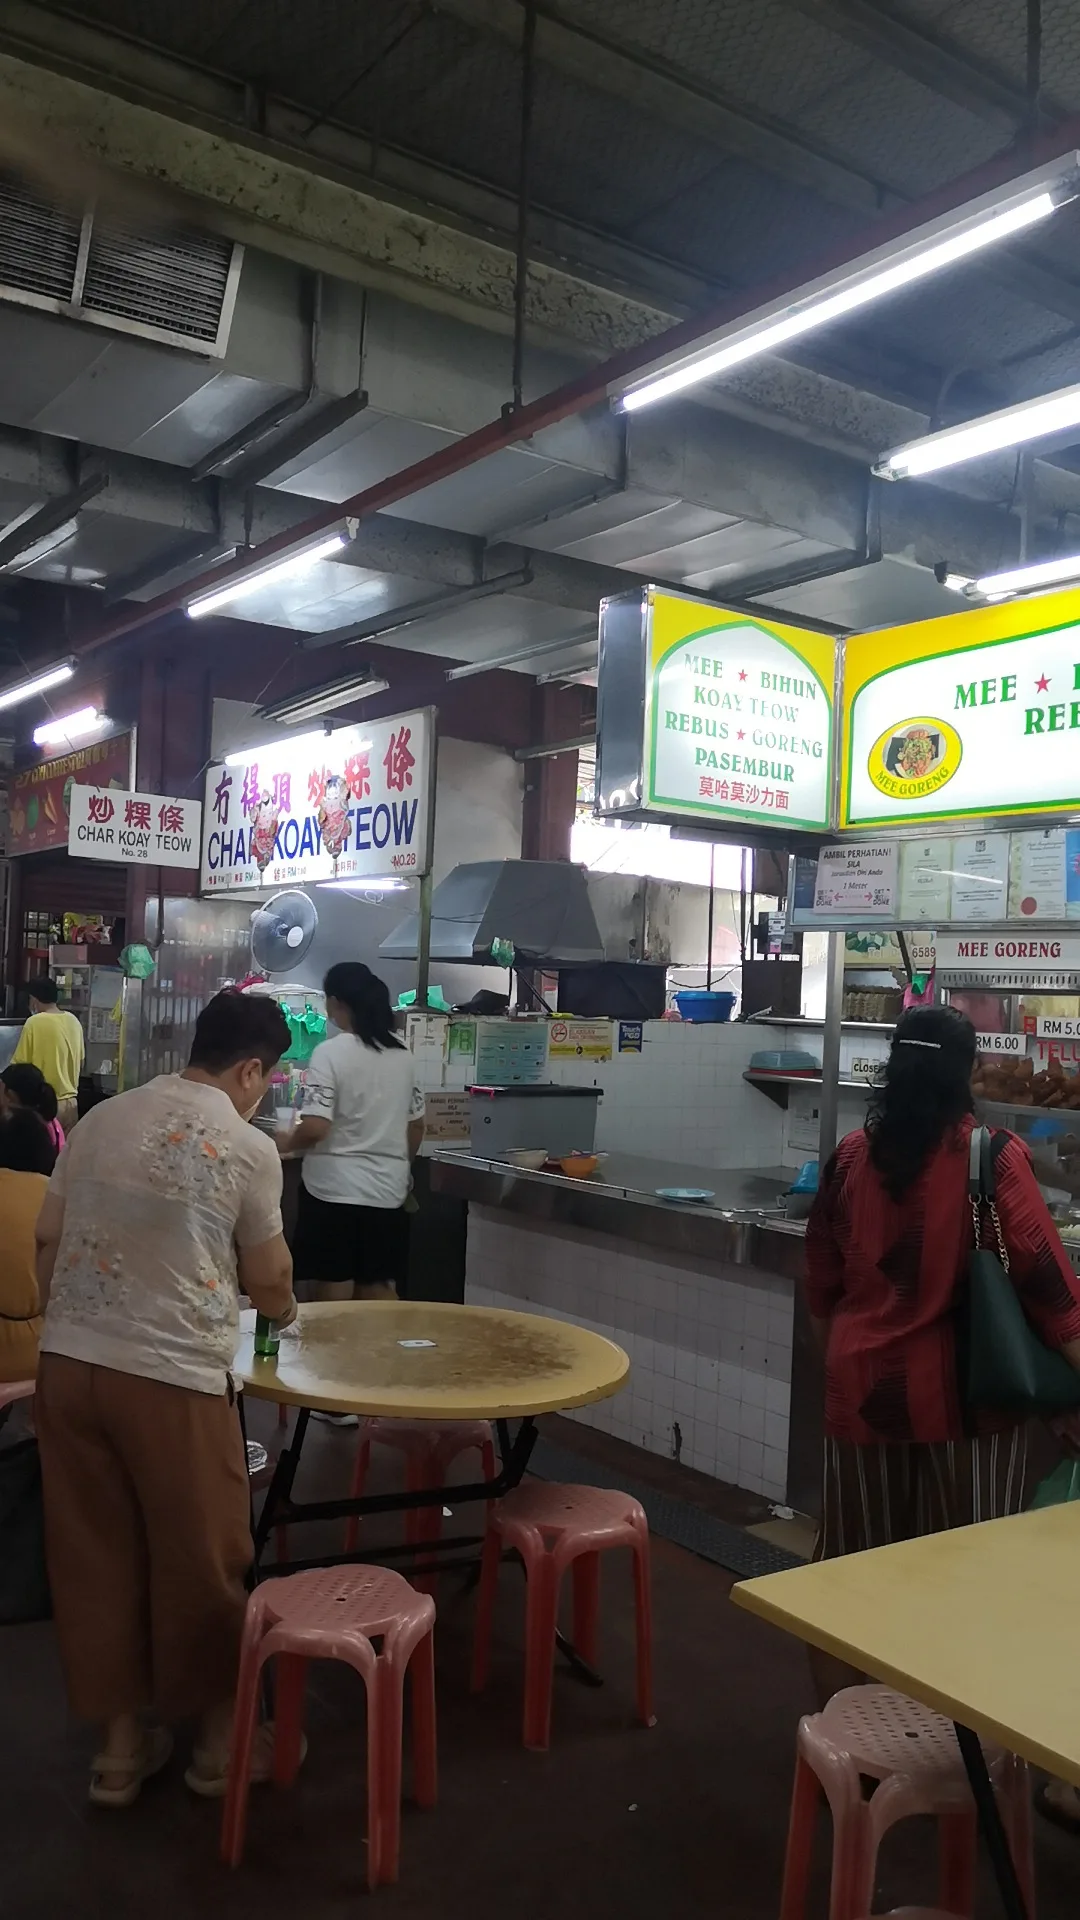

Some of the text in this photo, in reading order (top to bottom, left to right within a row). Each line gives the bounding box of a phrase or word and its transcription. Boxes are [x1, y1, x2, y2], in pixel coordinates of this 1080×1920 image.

[684, 653, 817, 700] MEE BIHUN
[693, 685, 799, 723] KOAY TEOW
[954, 675, 1017, 709] MEE
[664, 710, 823, 758] REBUS GORENG
[694, 747, 795, 782] PASEMBUR
[699, 776, 790, 810] 莫哈莫沙力面
[875, 766, 950, 795] MEE GORENG
[87, 794, 184, 833] 炒粿條
[78, 825, 114, 844] CHAR
[118, 829, 151, 848] KOAY
[155, 834, 192, 852] TEOW
[121, 848, 148, 858] No. 28
[824, 847, 891, 859] AMBIL PERHATIAN!
[847, 860, 860, 868] SILA
[911, 947, 936, 958] 6589
[957, 942, 1062, 958] MEE GORENG
[1043, 1020, 1062, 1034] RM
[976, 1036, 1019, 1050] RM 6.00
